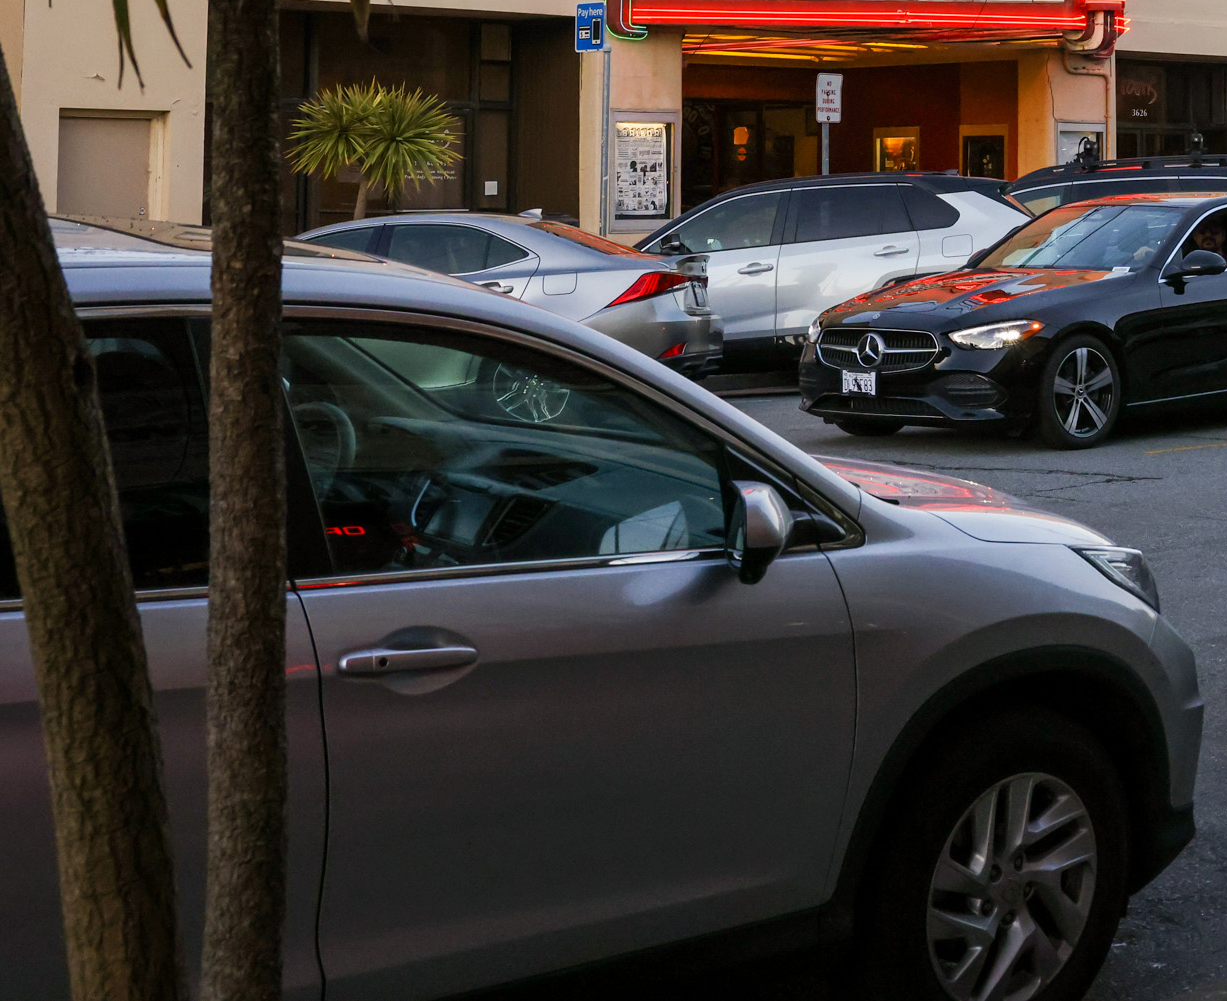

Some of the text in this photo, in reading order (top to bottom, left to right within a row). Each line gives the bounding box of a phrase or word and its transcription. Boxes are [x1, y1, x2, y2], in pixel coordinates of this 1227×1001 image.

[578, 7, 603, 19] Pay here
[1131, 109, 1148, 117] 3626
